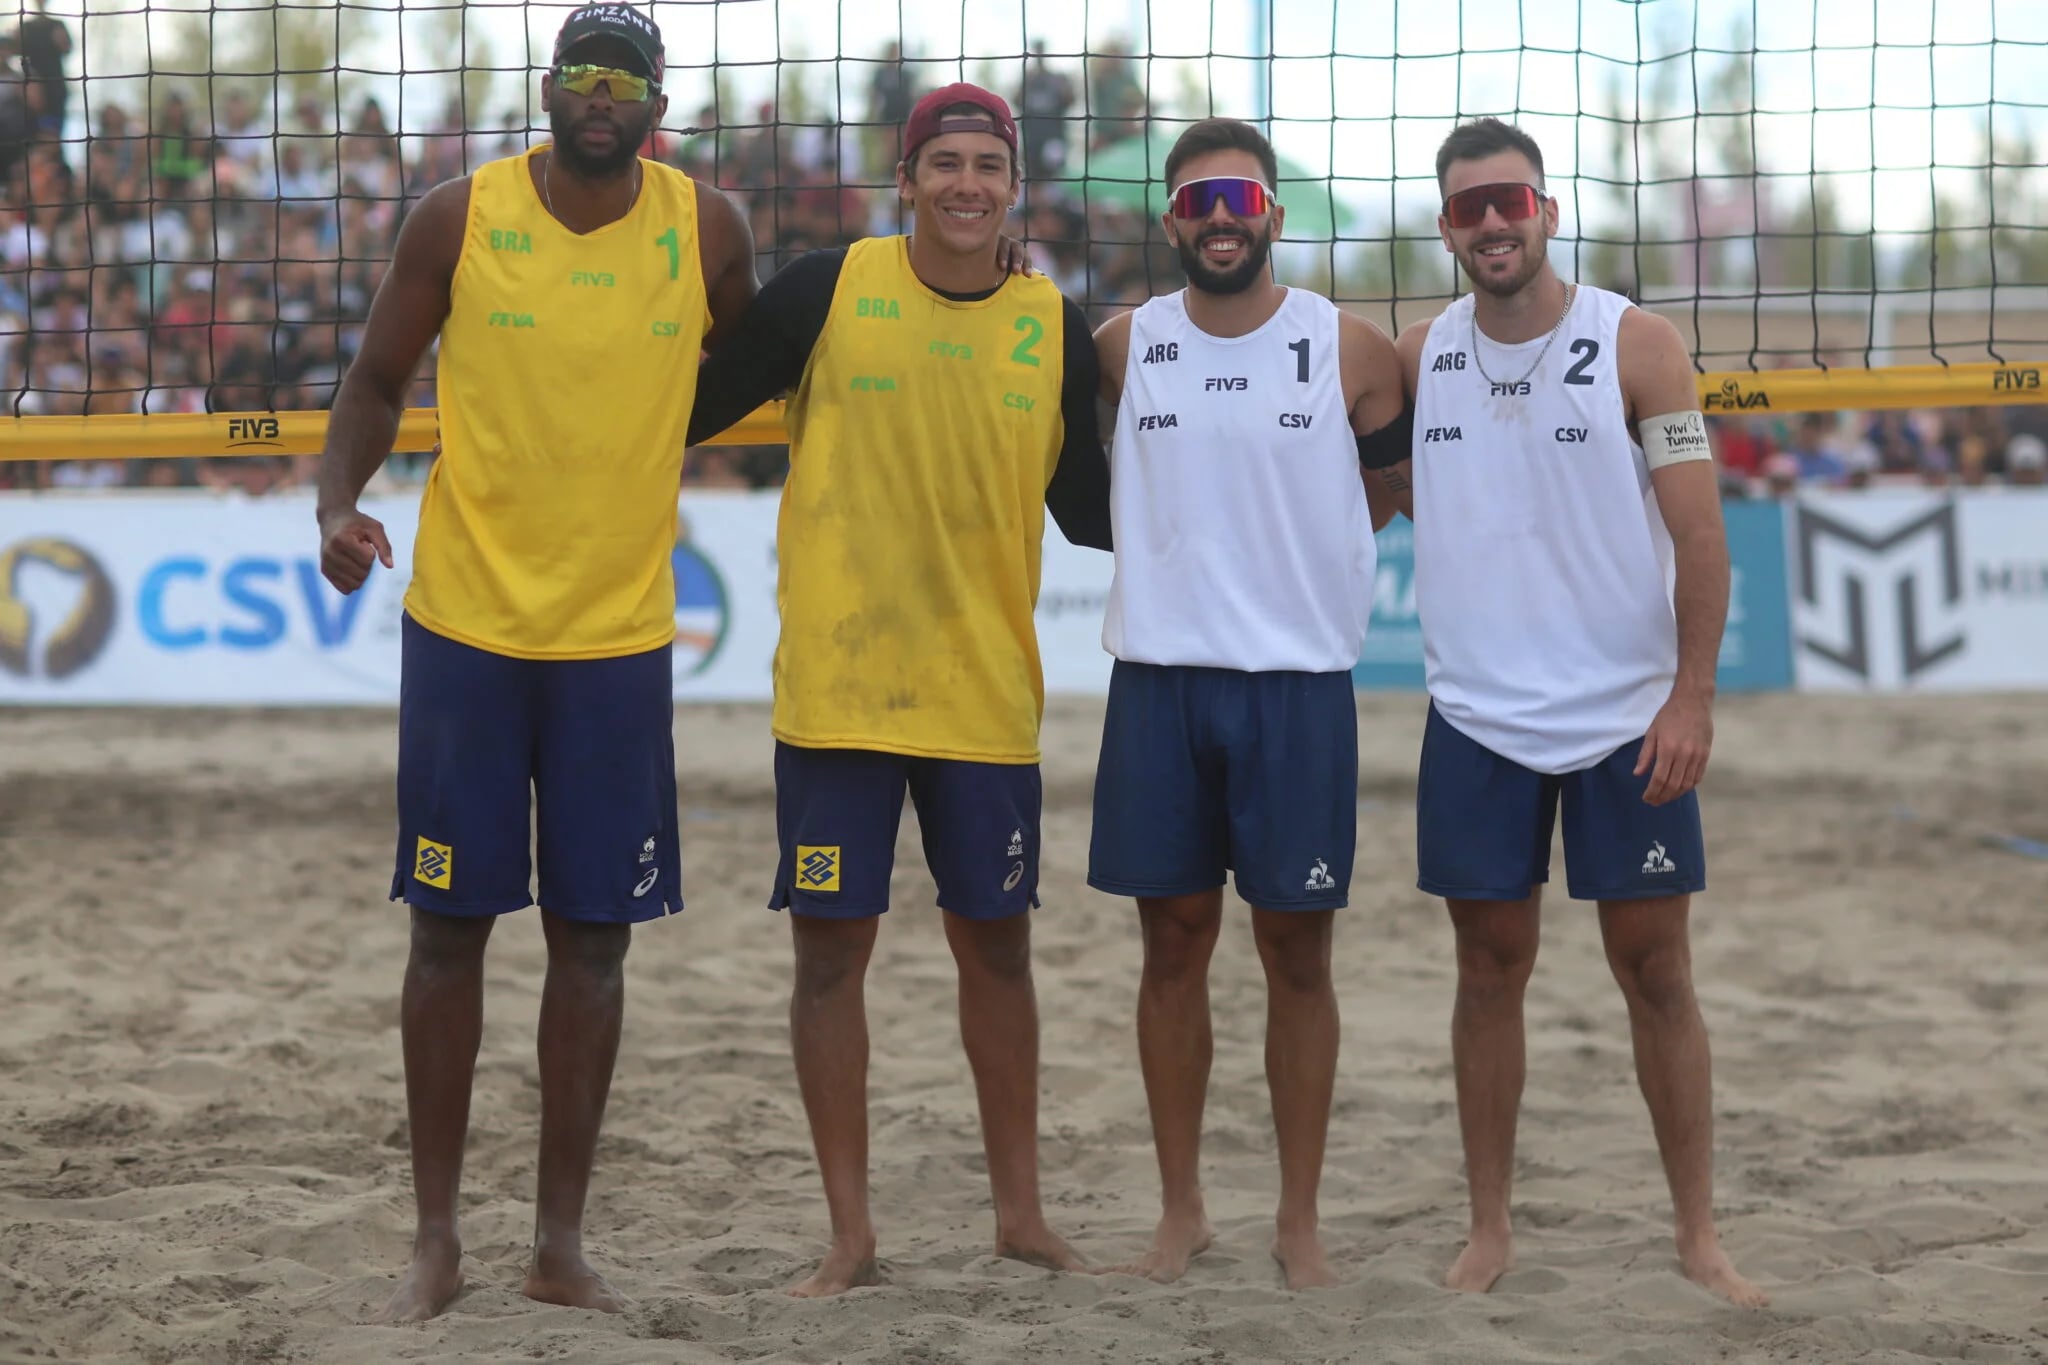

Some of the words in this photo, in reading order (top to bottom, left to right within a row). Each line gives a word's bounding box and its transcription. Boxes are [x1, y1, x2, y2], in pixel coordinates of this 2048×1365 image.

[600, 15, 626, 26] MODA
[490, 229, 532, 254] BRA
[655, 226, 681, 281] 1
[570, 271, 615, 287] FIVB
[856, 297, 900, 320] BRA
[488, 312, 535, 329] FEVA
[652, 320, 681, 337] CSV
[1010, 315, 1044, 368] 2
[1142, 342, 1179, 364] ARG
[1288, 338, 1310, 383] 1
[1432, 352, 1467, 373] ARG
[1563, 338, 1600, 385] 2
[849, 376, 896, 391] FEVA
[1205, 377, 1248, 392] FIVB
[1490, 381, 1532, 397] FIVB
[1993, 369, 2041, 391] FIVB
[1002, 392, 1037, 413] CSV
[229, 419, 279, 438] FIVB
[1138, 413, 1178, 432] FEVA
[1278, 413, 1312, 430] CSV
[1424, 426, 1463, 443] FEVA
[1555, 428, 1588, 443] CSV
[138, 556, 374, 649] CSV
